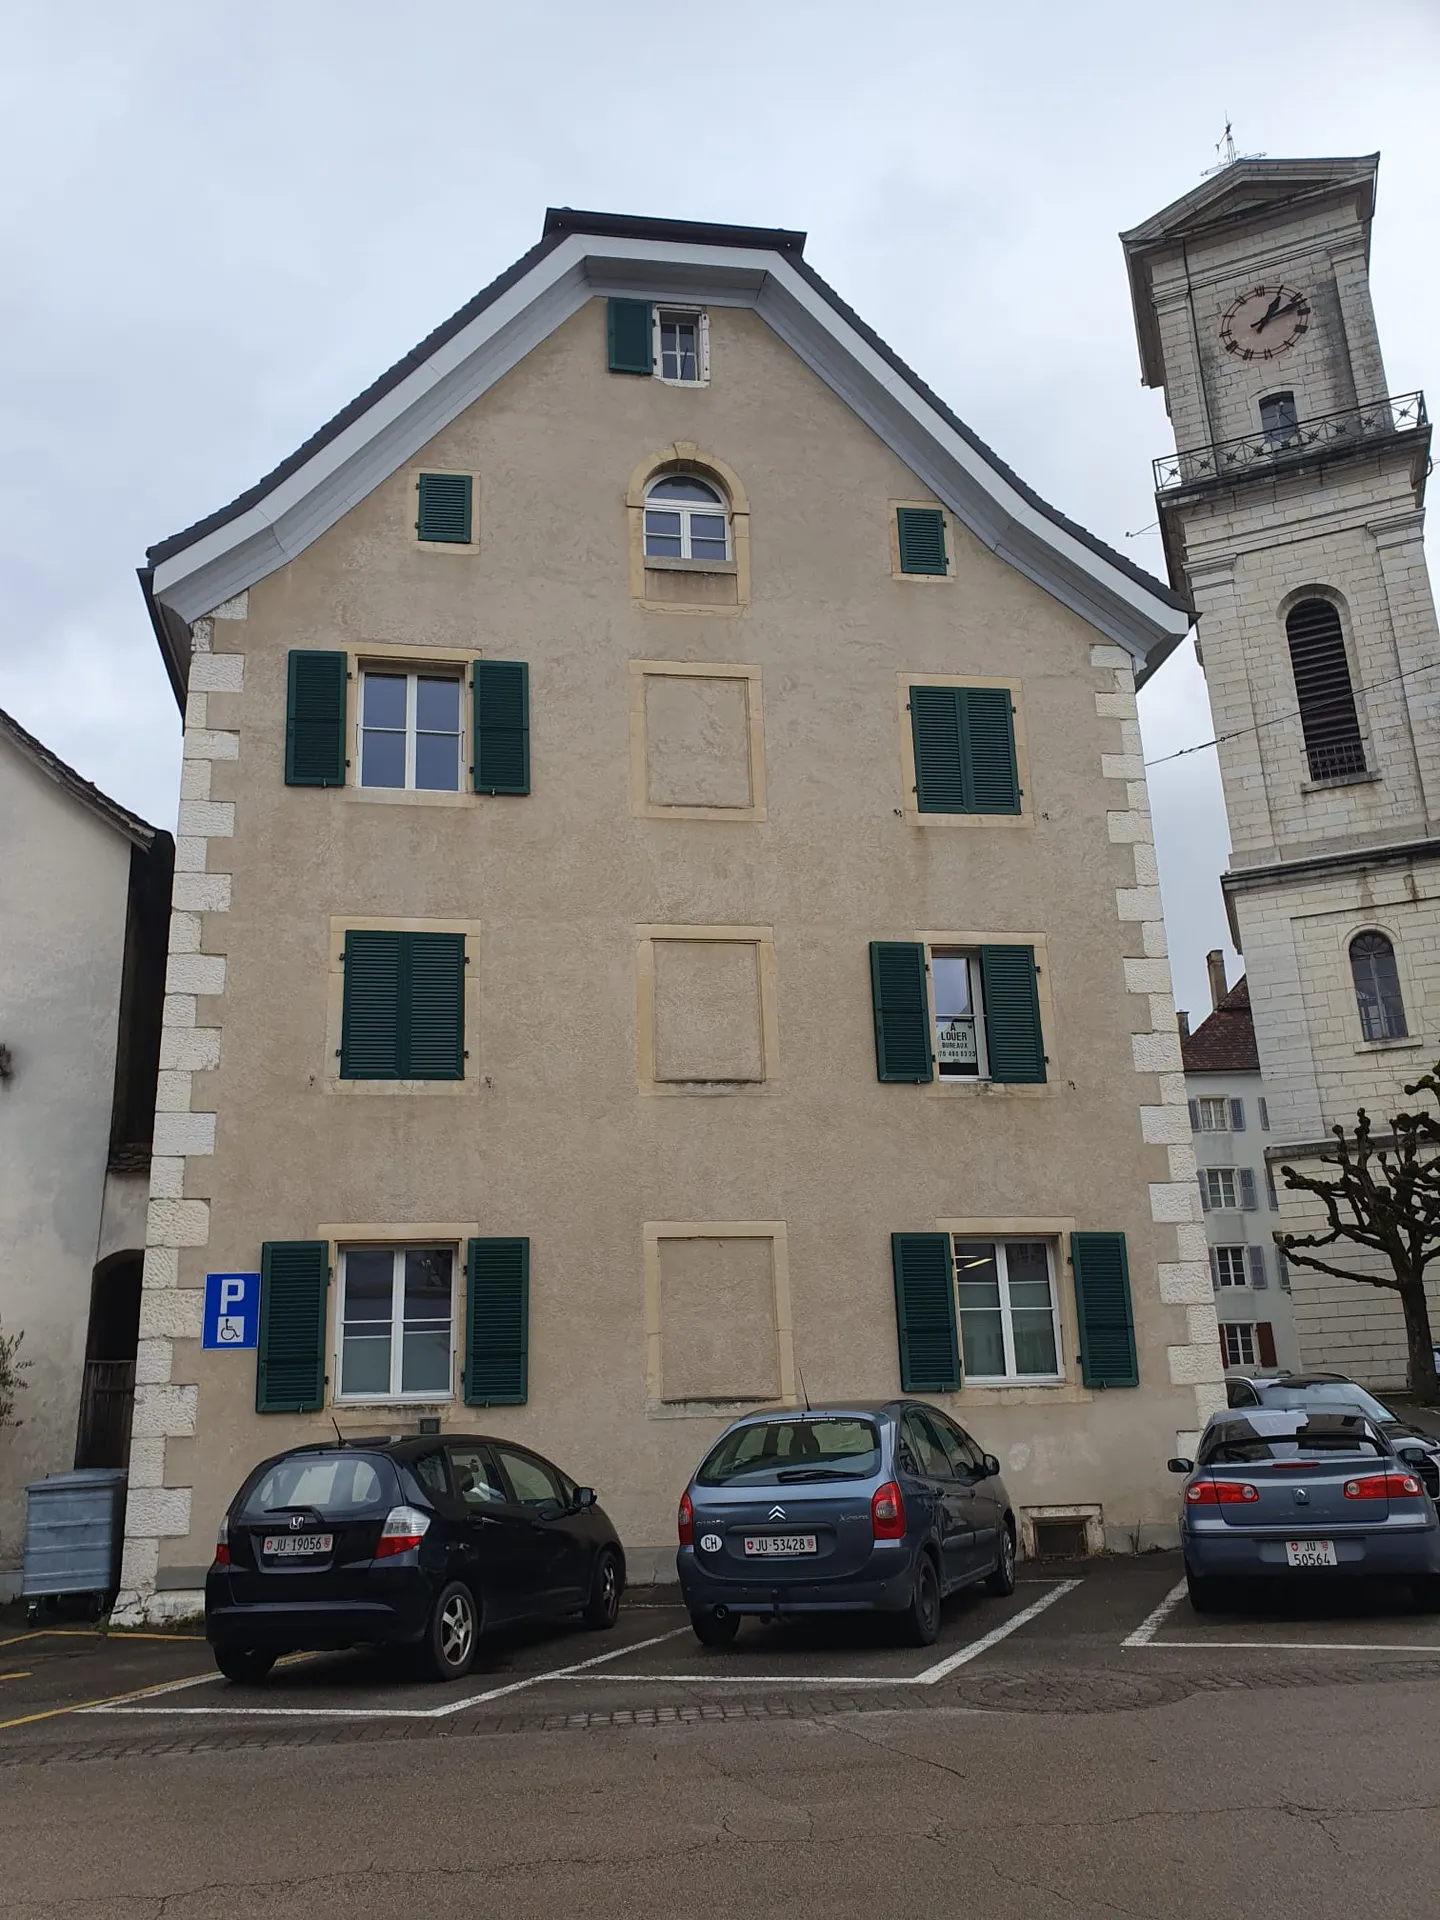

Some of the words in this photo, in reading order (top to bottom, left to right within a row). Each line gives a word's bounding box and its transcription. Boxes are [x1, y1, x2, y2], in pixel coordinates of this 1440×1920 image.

[950, 1022, 956, 1031] A
[941, 1032, 967, 1041] LOUER
[220, 1279, 245, 1314] P
[705, 1536, 718, 1550] CH
[1305, 1541, 1316, 1551] JU
[1293, 1553, 1330, 1566] 50564
